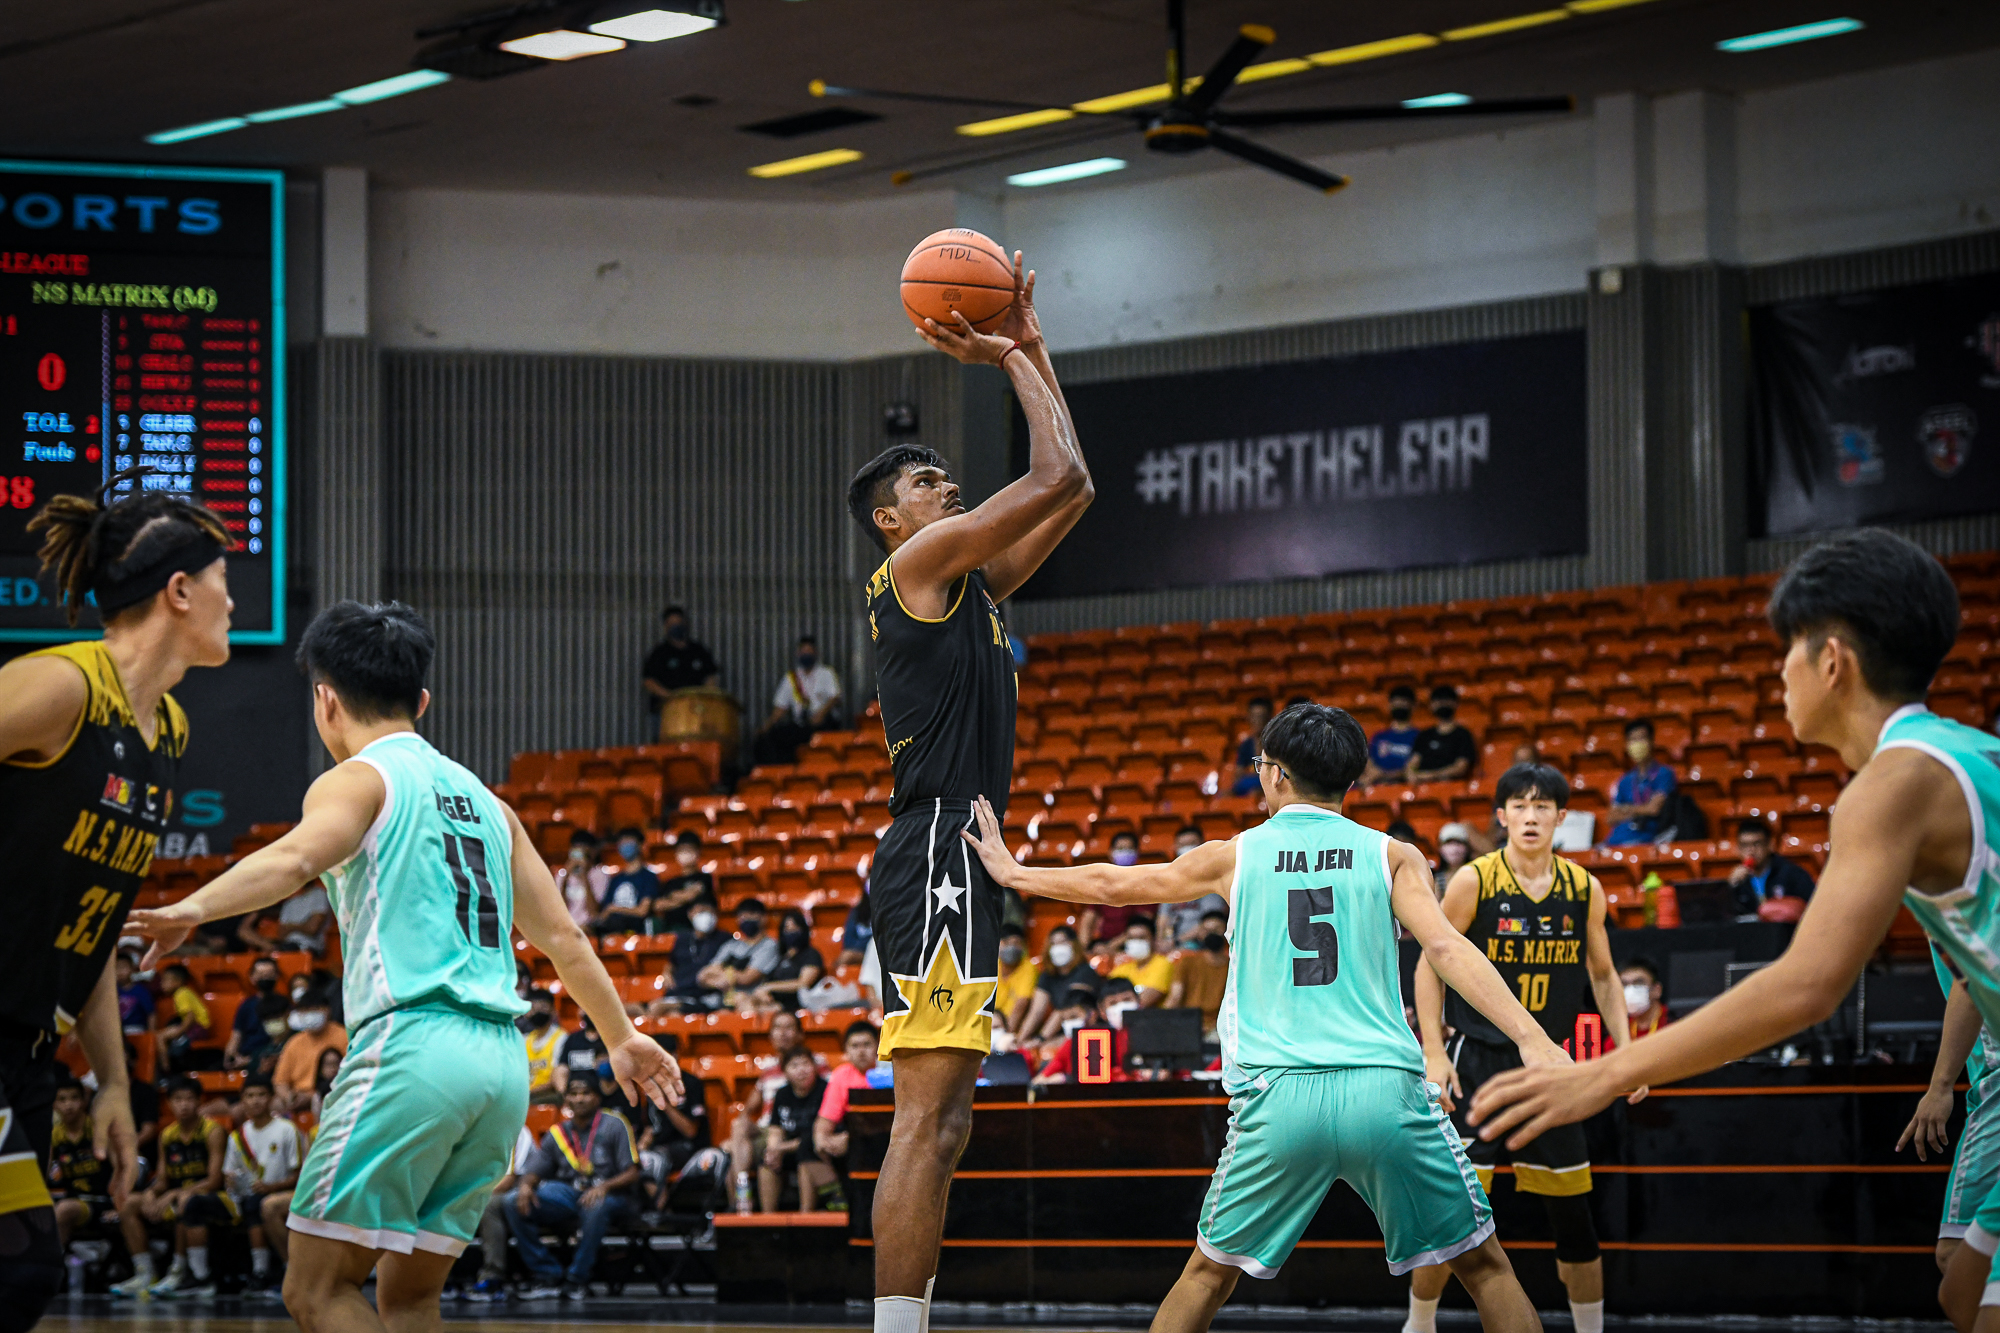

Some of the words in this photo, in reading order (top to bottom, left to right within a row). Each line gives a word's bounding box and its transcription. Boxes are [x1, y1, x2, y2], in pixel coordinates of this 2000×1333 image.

[0, 192, 222, 235] ORTS
[939, 247, 981, 263] MDL
[31, 280, 68, 304] NS
[71, 282, 170, 308] MATRIX
[37, 352, 67, 392] 0
[62, 809, 116, 864] N.S.
[1274, 850, 1309, 873] JIA
[1314, 848, 1353, 872] JEN
[443, 832, 500, 949] 11
[1288, 886, 1338, 987] 5
[1487, 938, 1518, 963] N.S.
[1522, 939, 1581, 964] MATRIX
[1517, 972, 1550, 1011] 10
[1077, 1029, 1112, 1084] 0
